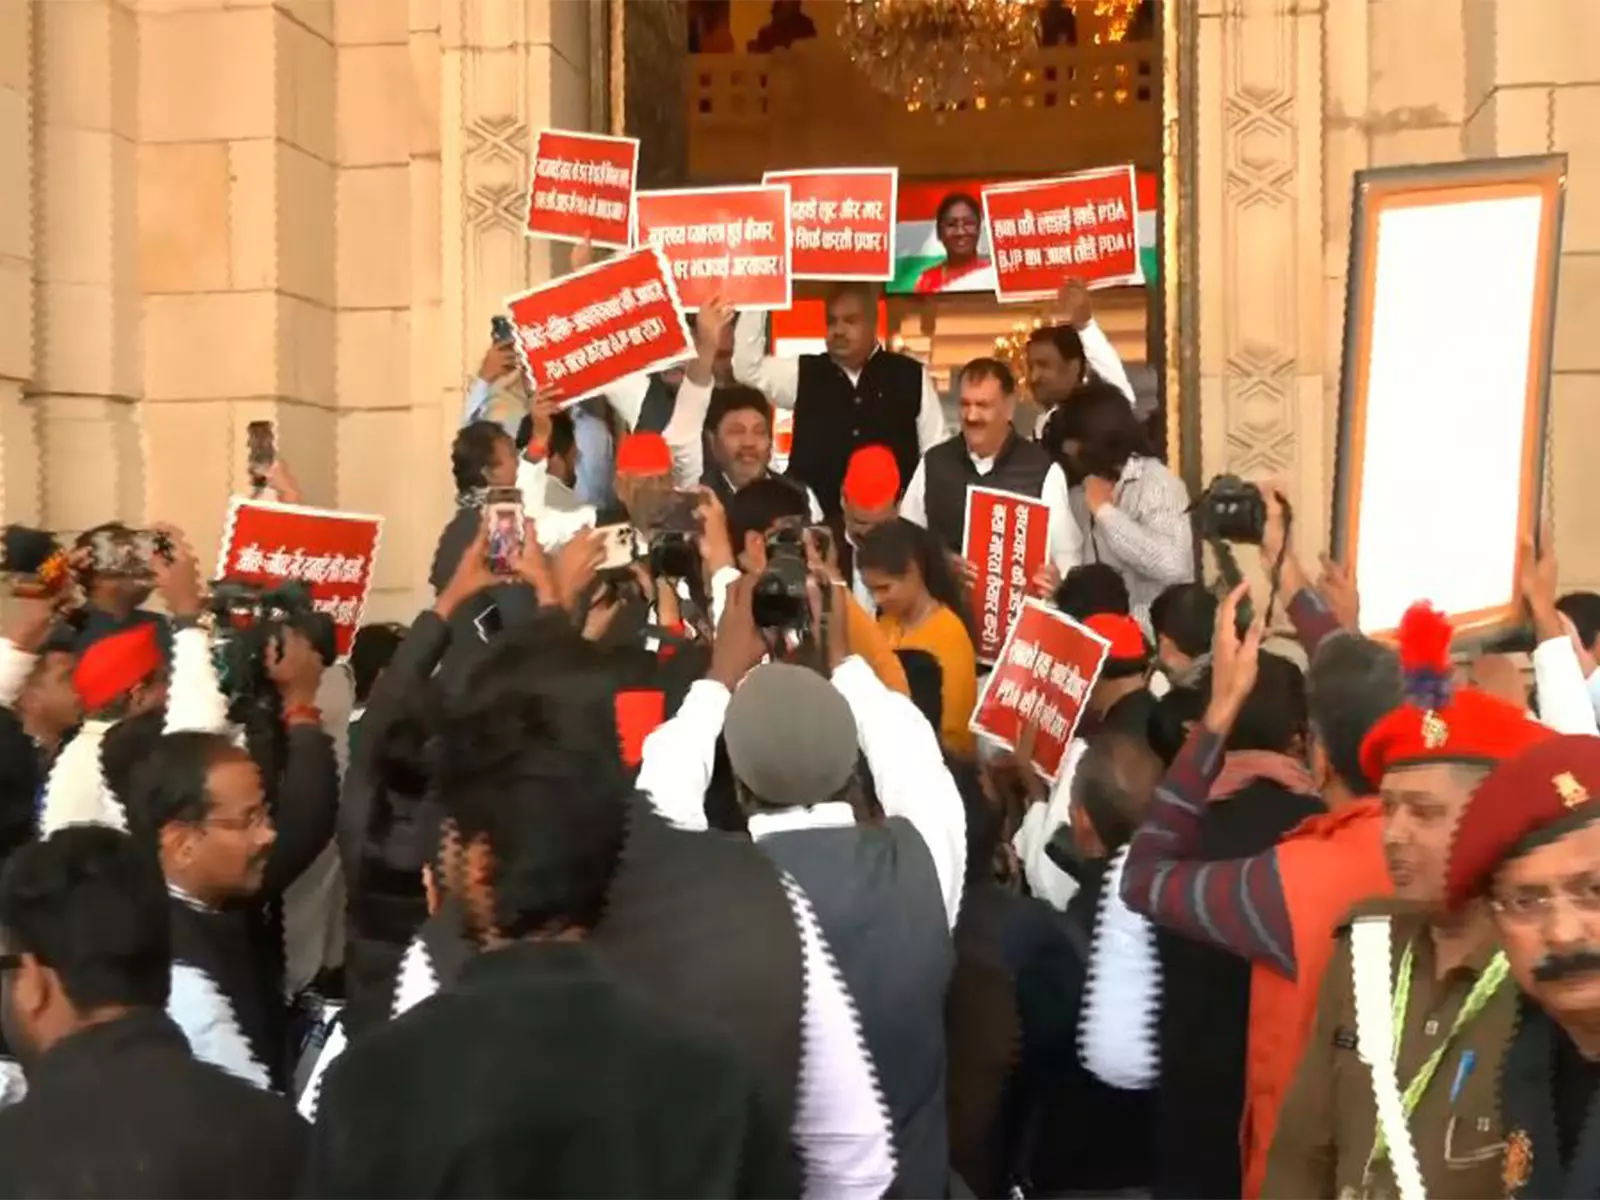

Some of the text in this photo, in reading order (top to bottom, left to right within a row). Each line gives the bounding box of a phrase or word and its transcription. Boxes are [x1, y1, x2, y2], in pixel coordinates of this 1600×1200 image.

[840, 197, 860, 220] और
[1098, 197, 1128, 224] PDA
[997, 248, 1023, 274] BJP
[987, 534, 1004, 574] भारत
